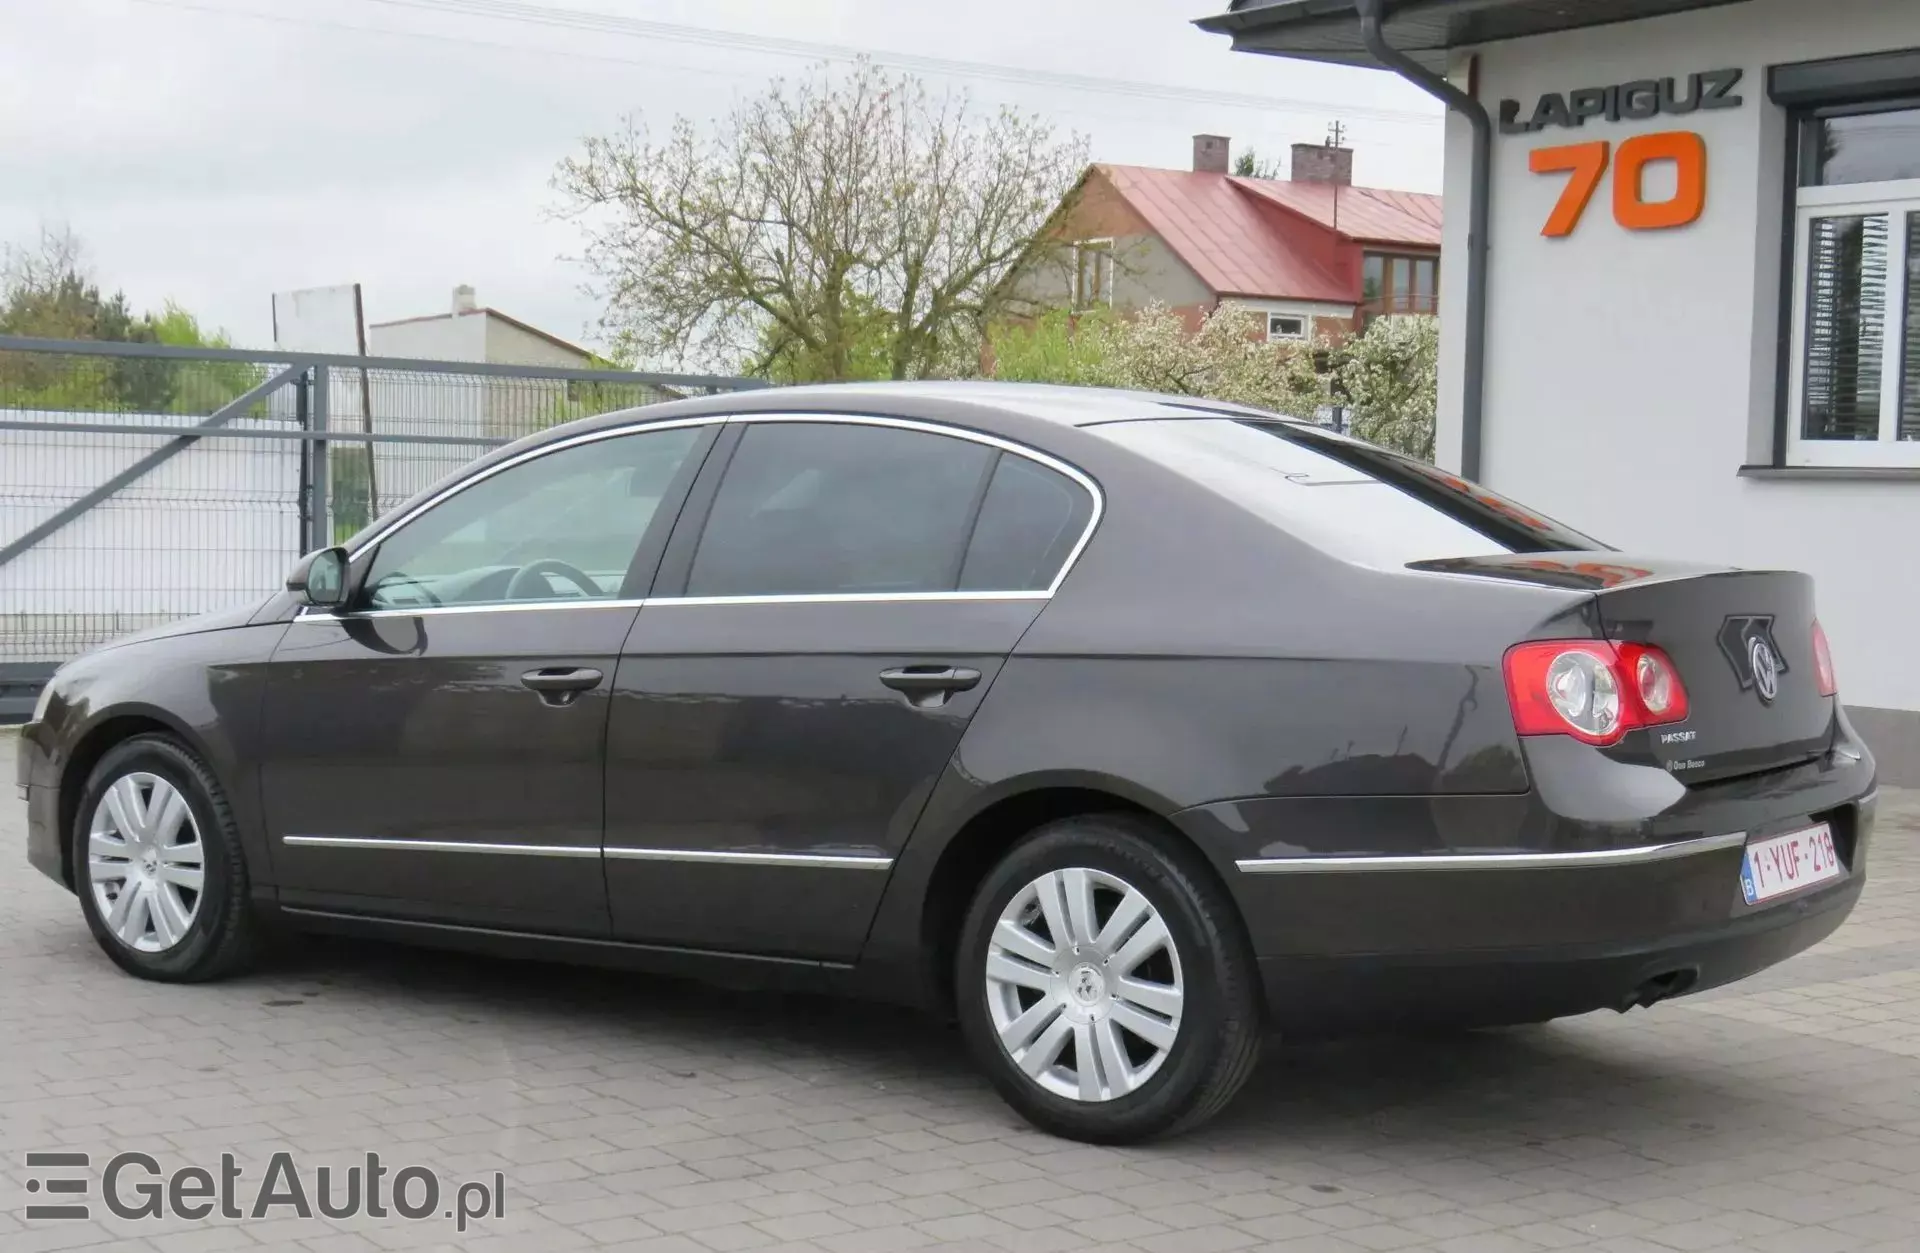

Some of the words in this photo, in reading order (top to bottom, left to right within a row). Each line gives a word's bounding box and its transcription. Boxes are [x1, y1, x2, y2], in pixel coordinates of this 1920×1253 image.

[1529, 131, 1707, 237] 70
[1661, 731, 1696, 744] PASSAT
[1744, 878, 1755, 896] B
